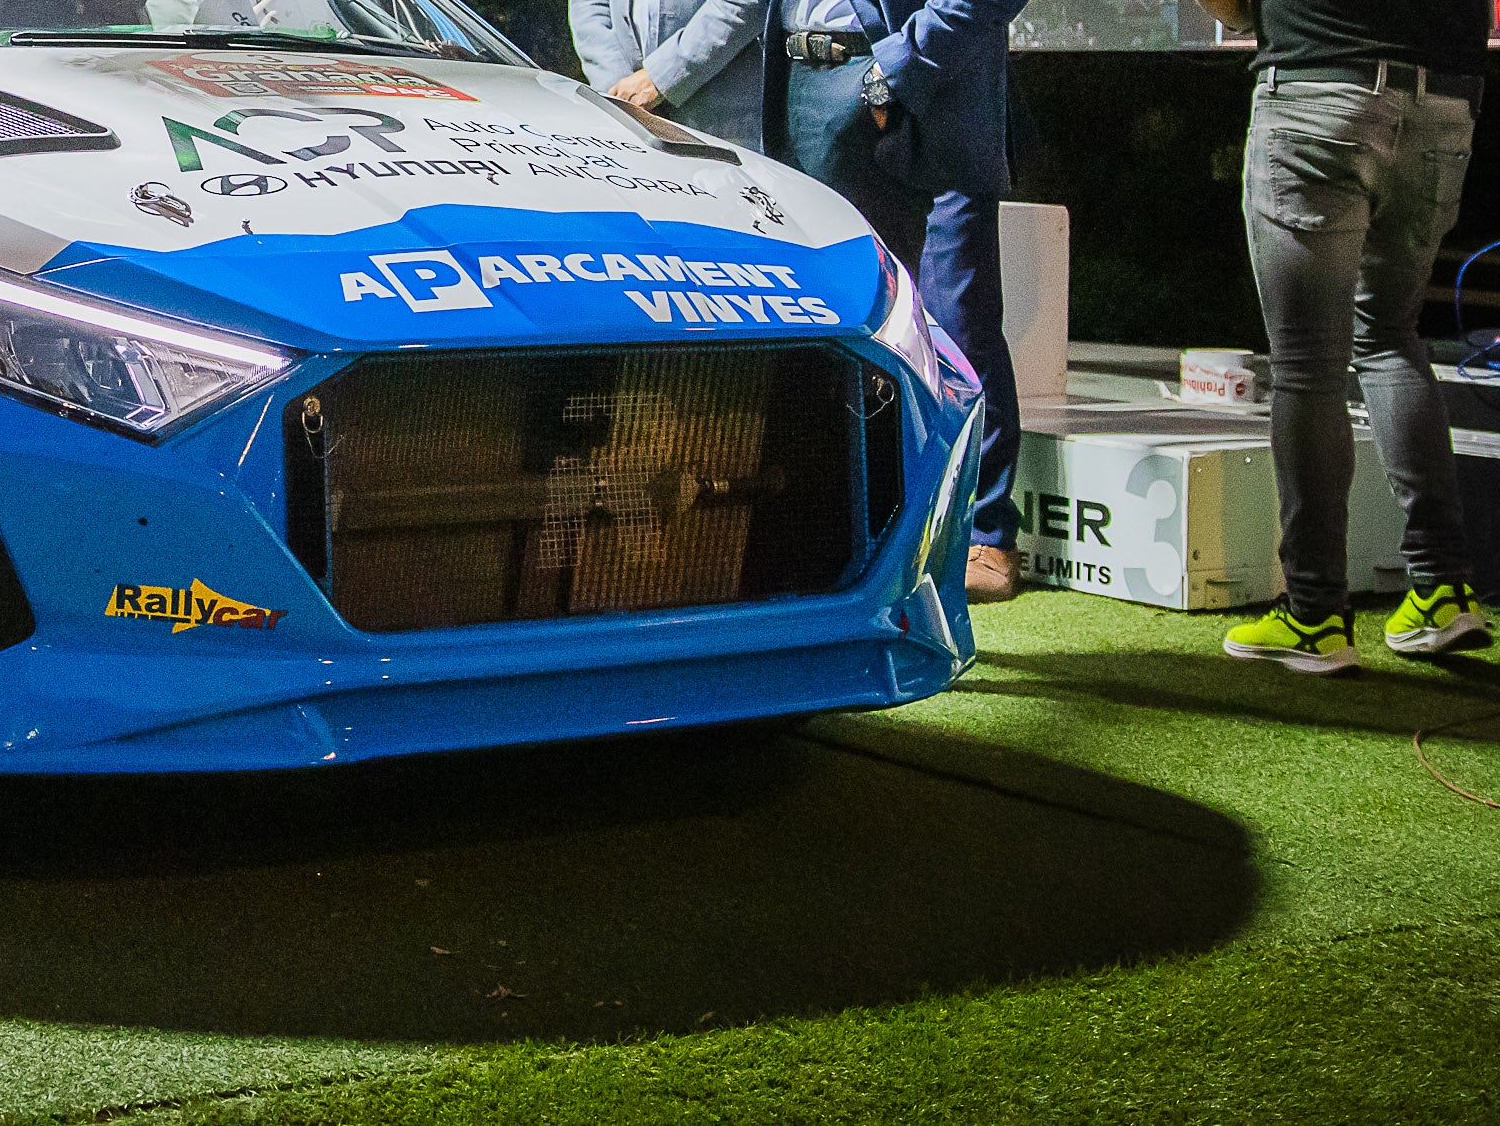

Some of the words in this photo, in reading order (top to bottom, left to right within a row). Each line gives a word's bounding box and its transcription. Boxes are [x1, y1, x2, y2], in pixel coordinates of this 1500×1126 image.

[183, 66, 437, 87] Granada
[423, 117, 514, 135] Auto
[519, 123, 647, 154] Centre
[294, 160, 512, 188] HYUNDAI
[528, 162, 718, 199] ANDORRA
[624, 290, 841, 326] VINYES
[1122, 453, 1184, 605] 3
[1035, 554, 1112, 586] LIMITS
[114, 583, 288, 631] Rallycar
